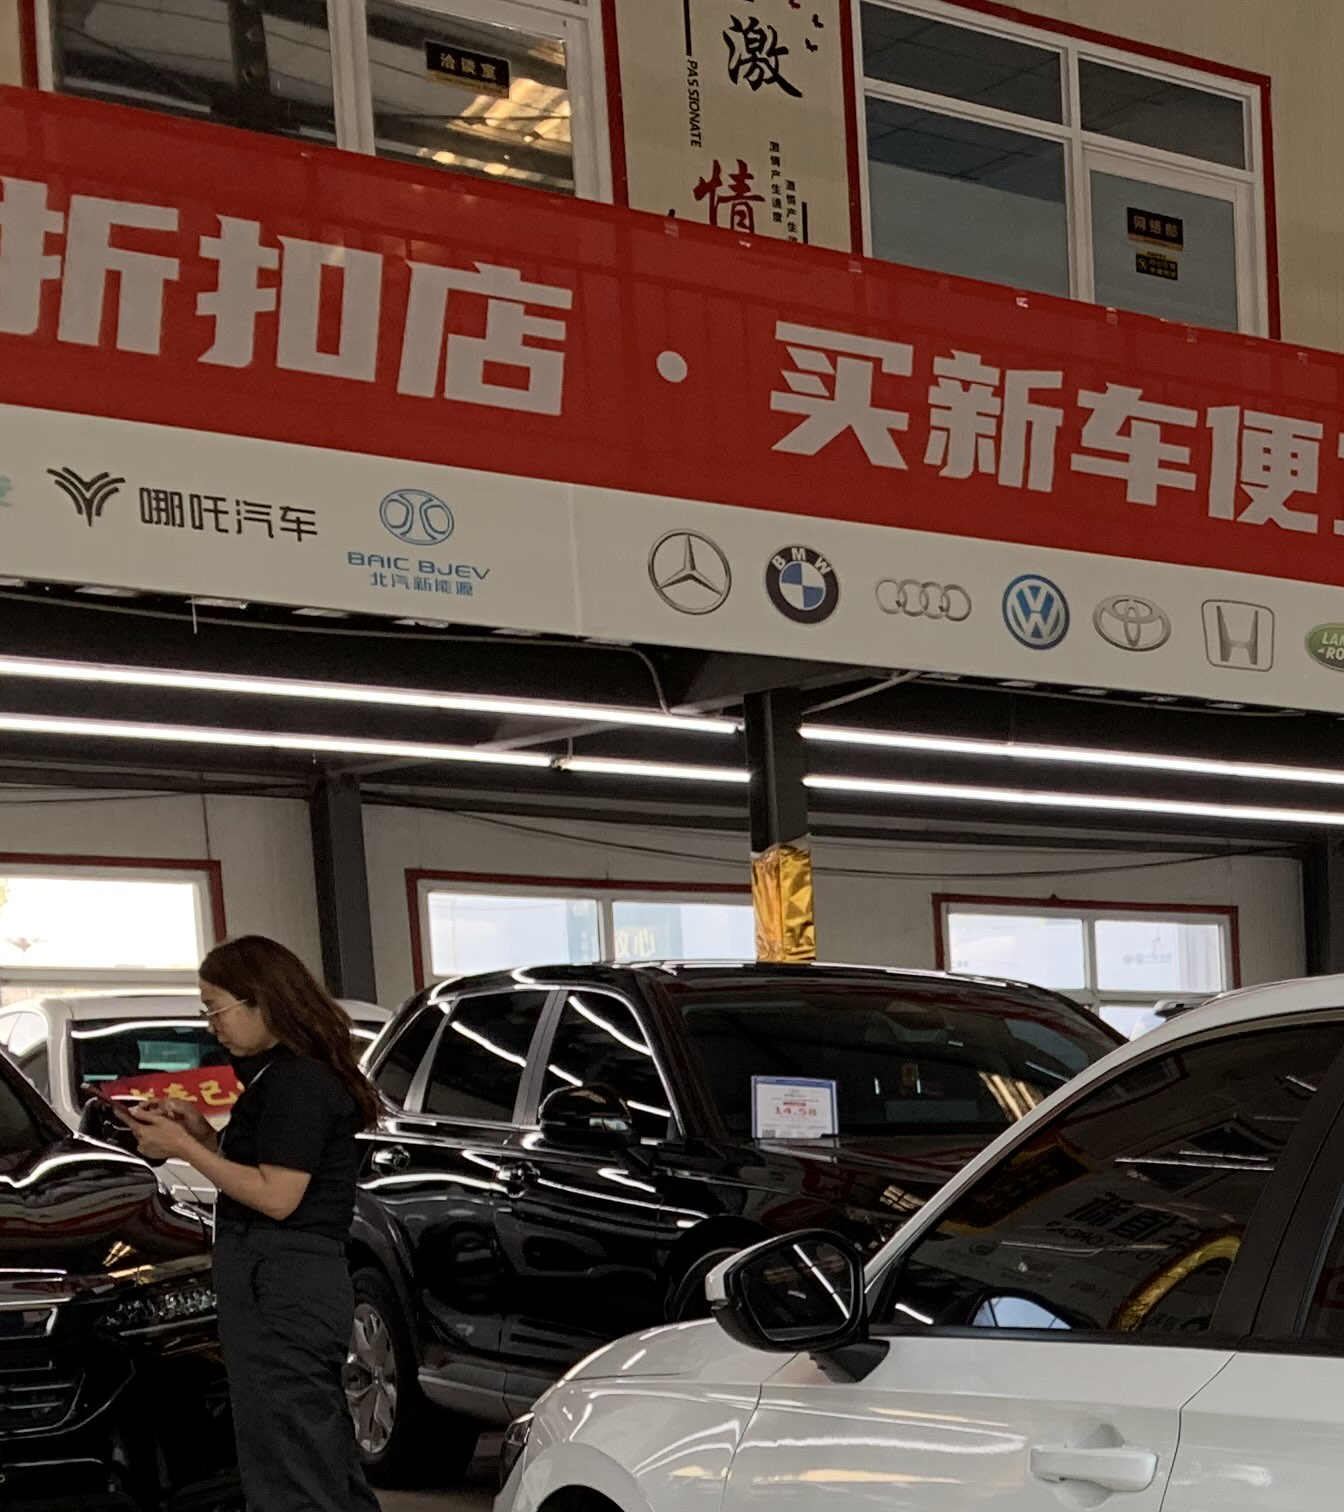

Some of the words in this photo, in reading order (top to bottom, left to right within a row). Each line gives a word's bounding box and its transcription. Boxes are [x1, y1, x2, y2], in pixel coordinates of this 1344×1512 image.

[685, 59, 702, 148] PASSIONATE
[0, 175, 573, 416] 折扣店
[139, 487, 317, 542] 哪吒汽车
[347, 551, 410, 571] BAIC
[418, 560, 490, 580] BJEV
[771, 547, 832, 575] BMW
